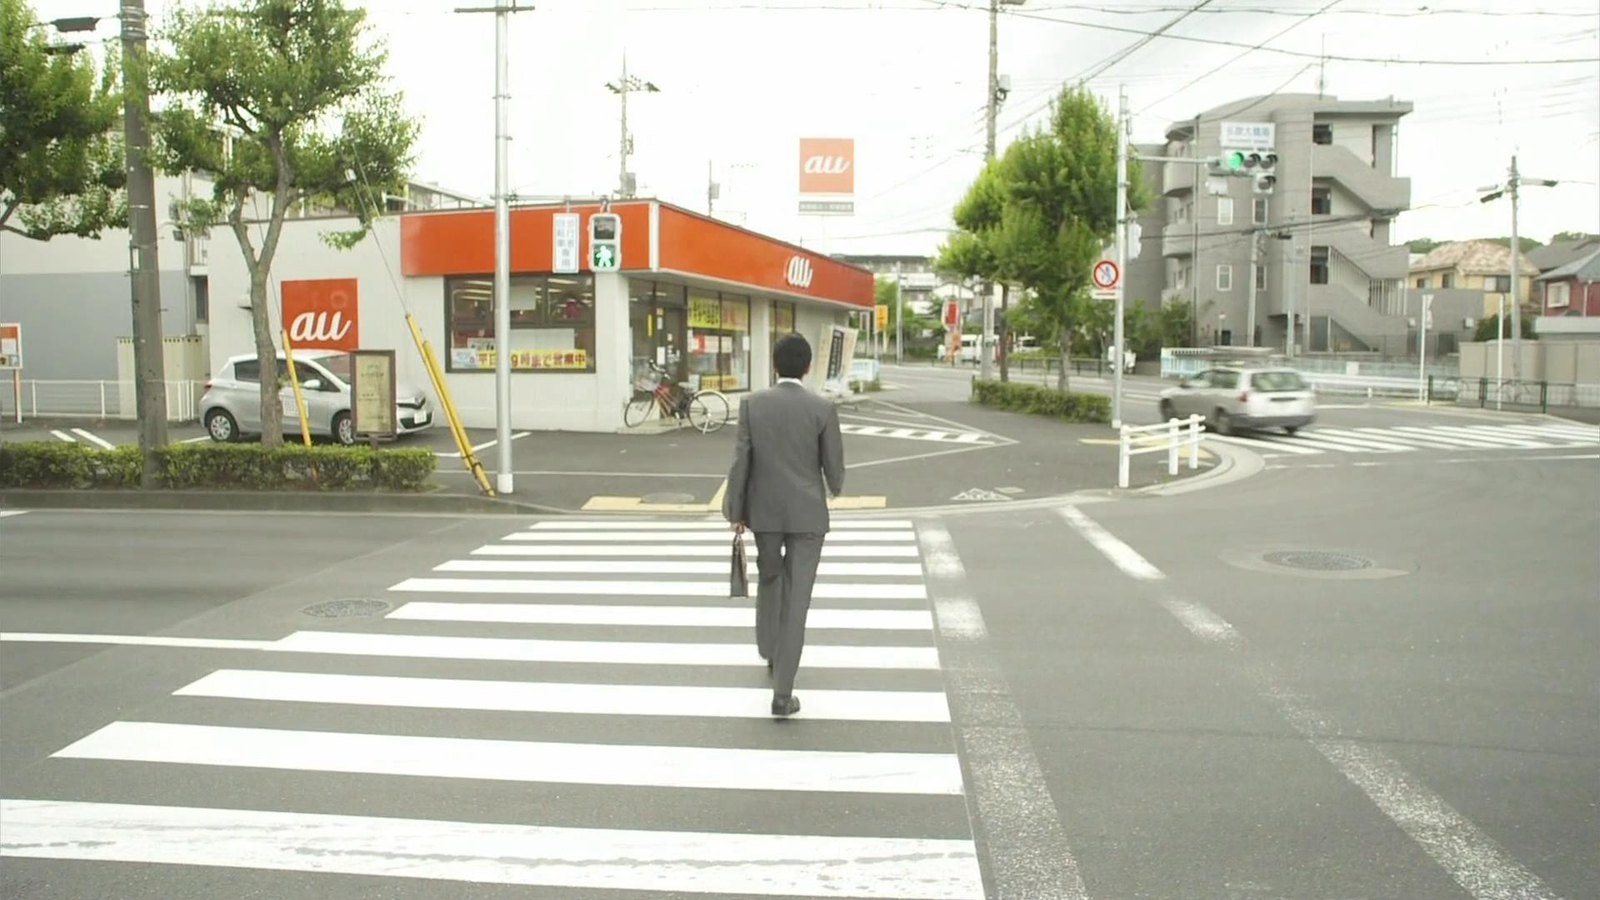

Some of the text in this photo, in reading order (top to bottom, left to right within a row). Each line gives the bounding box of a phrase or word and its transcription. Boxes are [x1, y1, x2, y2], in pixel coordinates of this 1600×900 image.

[804, 155, 850, 174] au
[787, 255, 813, 288] au
[290, 310, 352, 341] au
